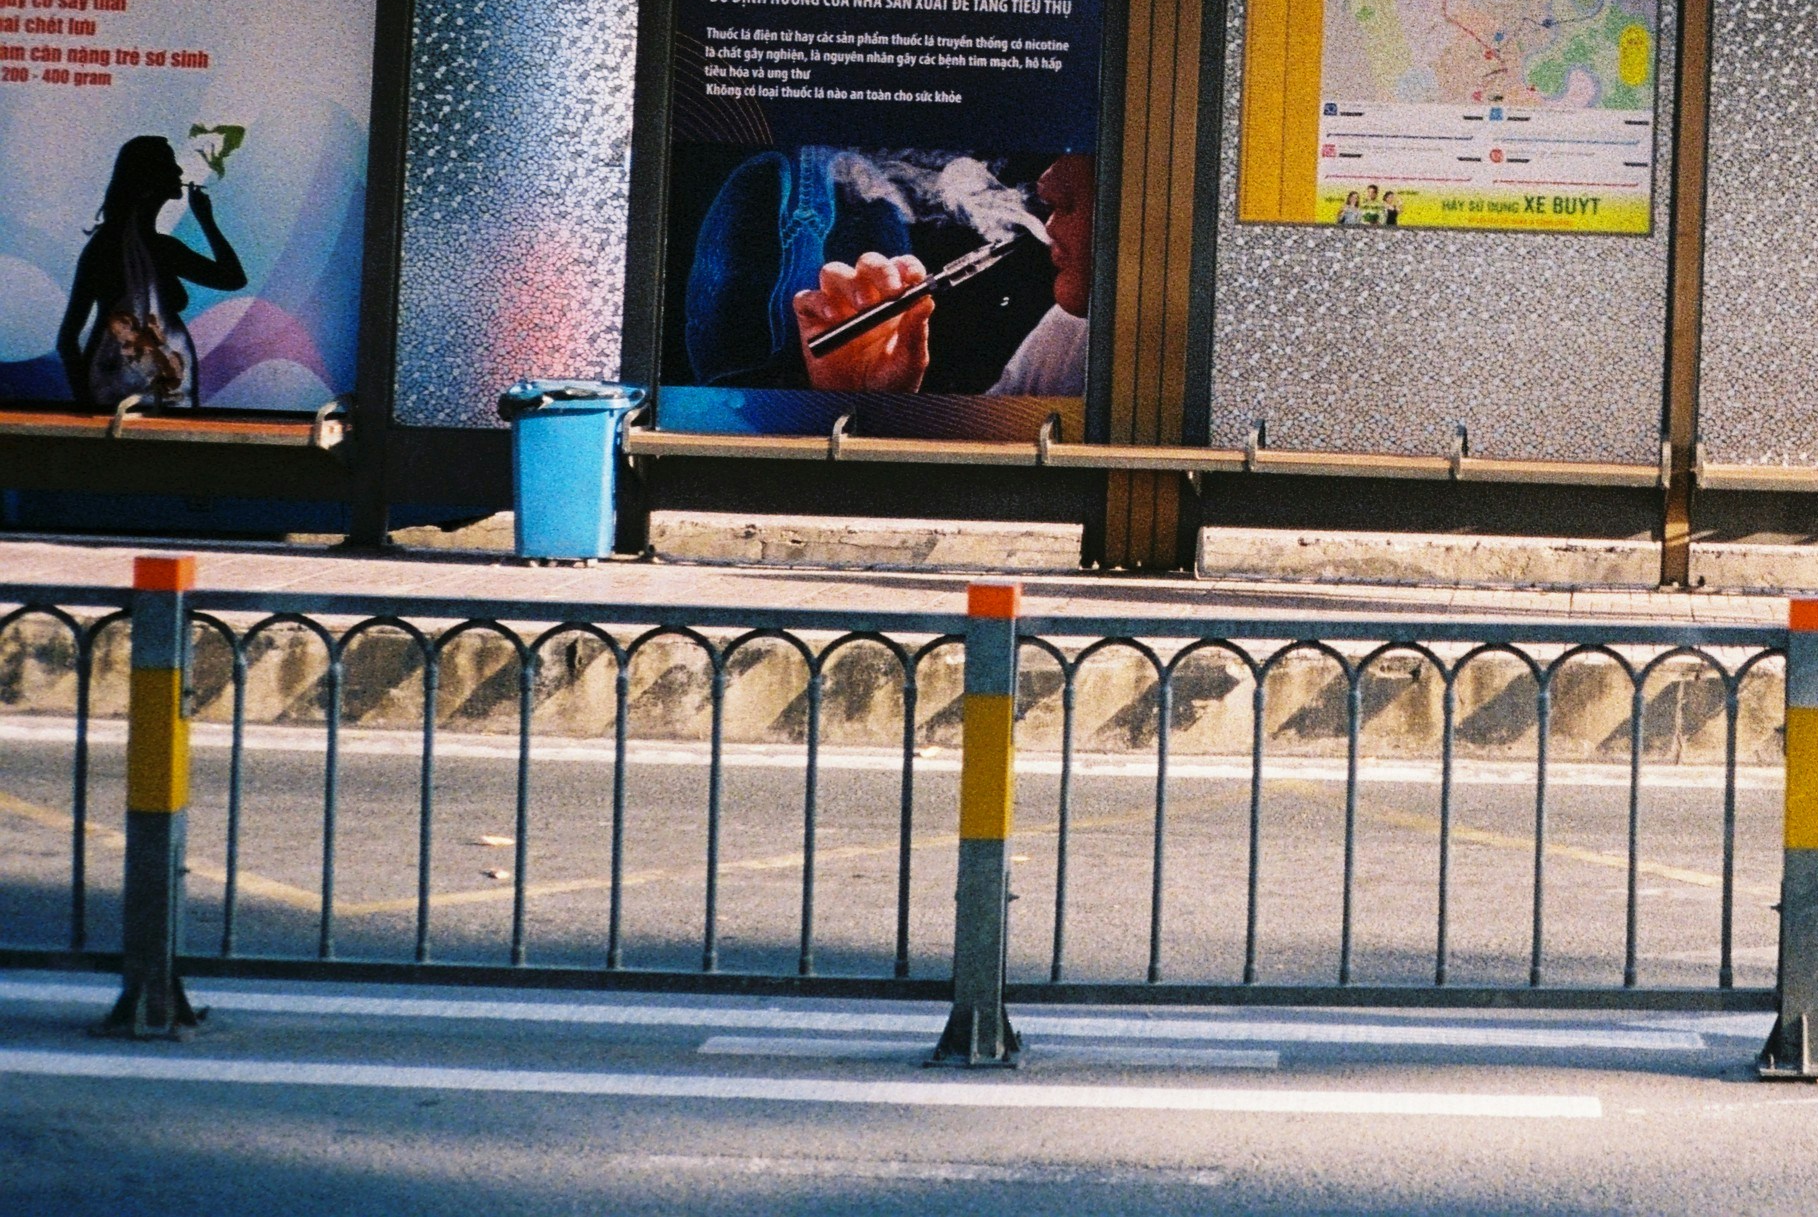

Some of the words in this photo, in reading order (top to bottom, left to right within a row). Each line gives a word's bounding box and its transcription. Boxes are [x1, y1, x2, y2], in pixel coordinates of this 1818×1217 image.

[1044, 0, 1072, 19] THỤ
[706, 27, 739, 40] Thuốc
[740, 28, 751, 41] lá
[753, 29, 778, 44] điện
[780, 29, 794, 42] tử
[794, 31, 815, 45] hay
[816, 32, 834, 44] các
[836, 31, 855, 44] sản
[857, 31, 889, 47] phẩm
[891, 32, 922, 46] thuốc
[924, 35, 935, 47] lá
[975, 35, 1008, 52] thống
[1010, 37, 1023, 50] có
[1025, 38, 1070, 52] nicotine
[717, 45, 742, 59] chất
[743, 48, 764, 62] gây
[766, 47, 809, 63] nghiện,
[823, 51, 864, 66] nguyên
[866, 50, 894, 64] nhân
[896, 52, 916, 67] gây
[919, 52, 936, 65] các
[938, 53, 966, 69] bệnh
[968, 55, 988, 67] tim
[989, 55, 1023, 71] mạch,
[1041, 56, 1062, 72] hấp
[704, 65, 727, 77] tiêu
[728, 65, 750, 78] hóa
[751, 66, 765, 79] và
[767, 69, 788, 83] ung
[790, 68, 811, 80] thư
[706, 83, 742, 98] Không
[744, 85, 756, 97] có
[757, 84, 779, 100] loại
[781, 83, 812, 99] thuốc
[814, 86, 825, 98] lá
[827, 87, 848, 100] nào
[849, 89, 864, 100] an
[866, 88, 892, 101] toàn
[893, 89, 913, 102] cho
[915, 89, 933, 102] sức
[934, 90, 962, 103] khỏe
[1524, 195, 1547, 215] XE
[1552, 193, 1601, 216] BUÝT
